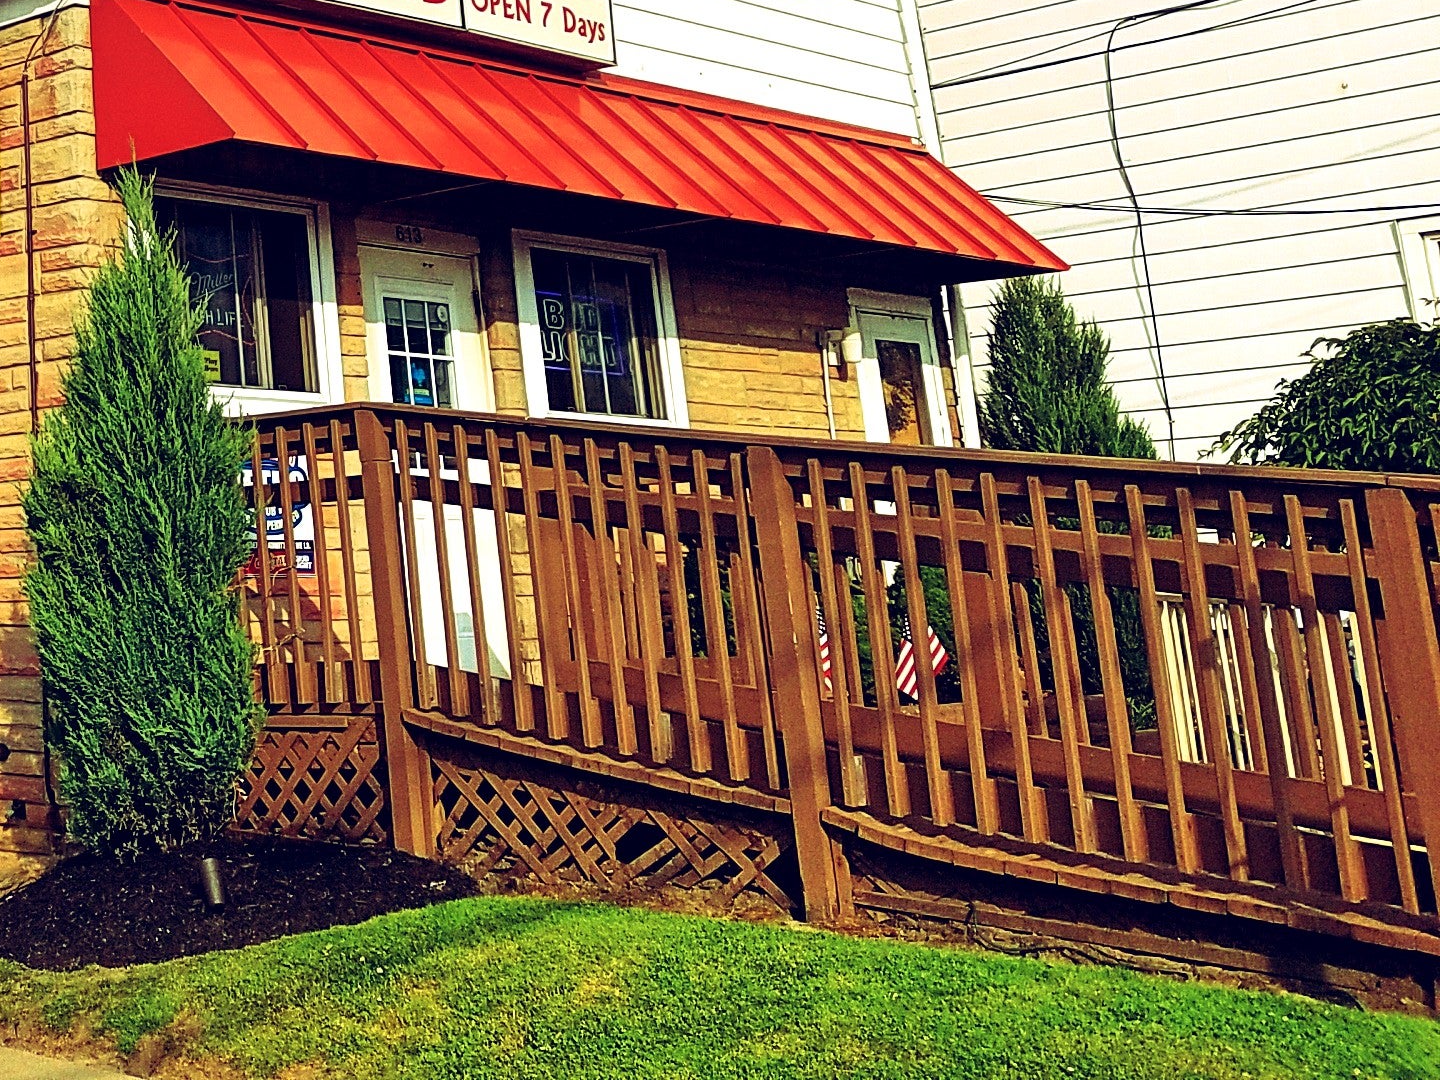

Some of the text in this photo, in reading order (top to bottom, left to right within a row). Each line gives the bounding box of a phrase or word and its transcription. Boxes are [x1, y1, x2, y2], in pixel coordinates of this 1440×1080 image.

[541, 1, 552, 27] 7
[562, 6, 606, 43] Days
[395, 225, 423, 244] 613
[190, 270, 233, 297] Miller
